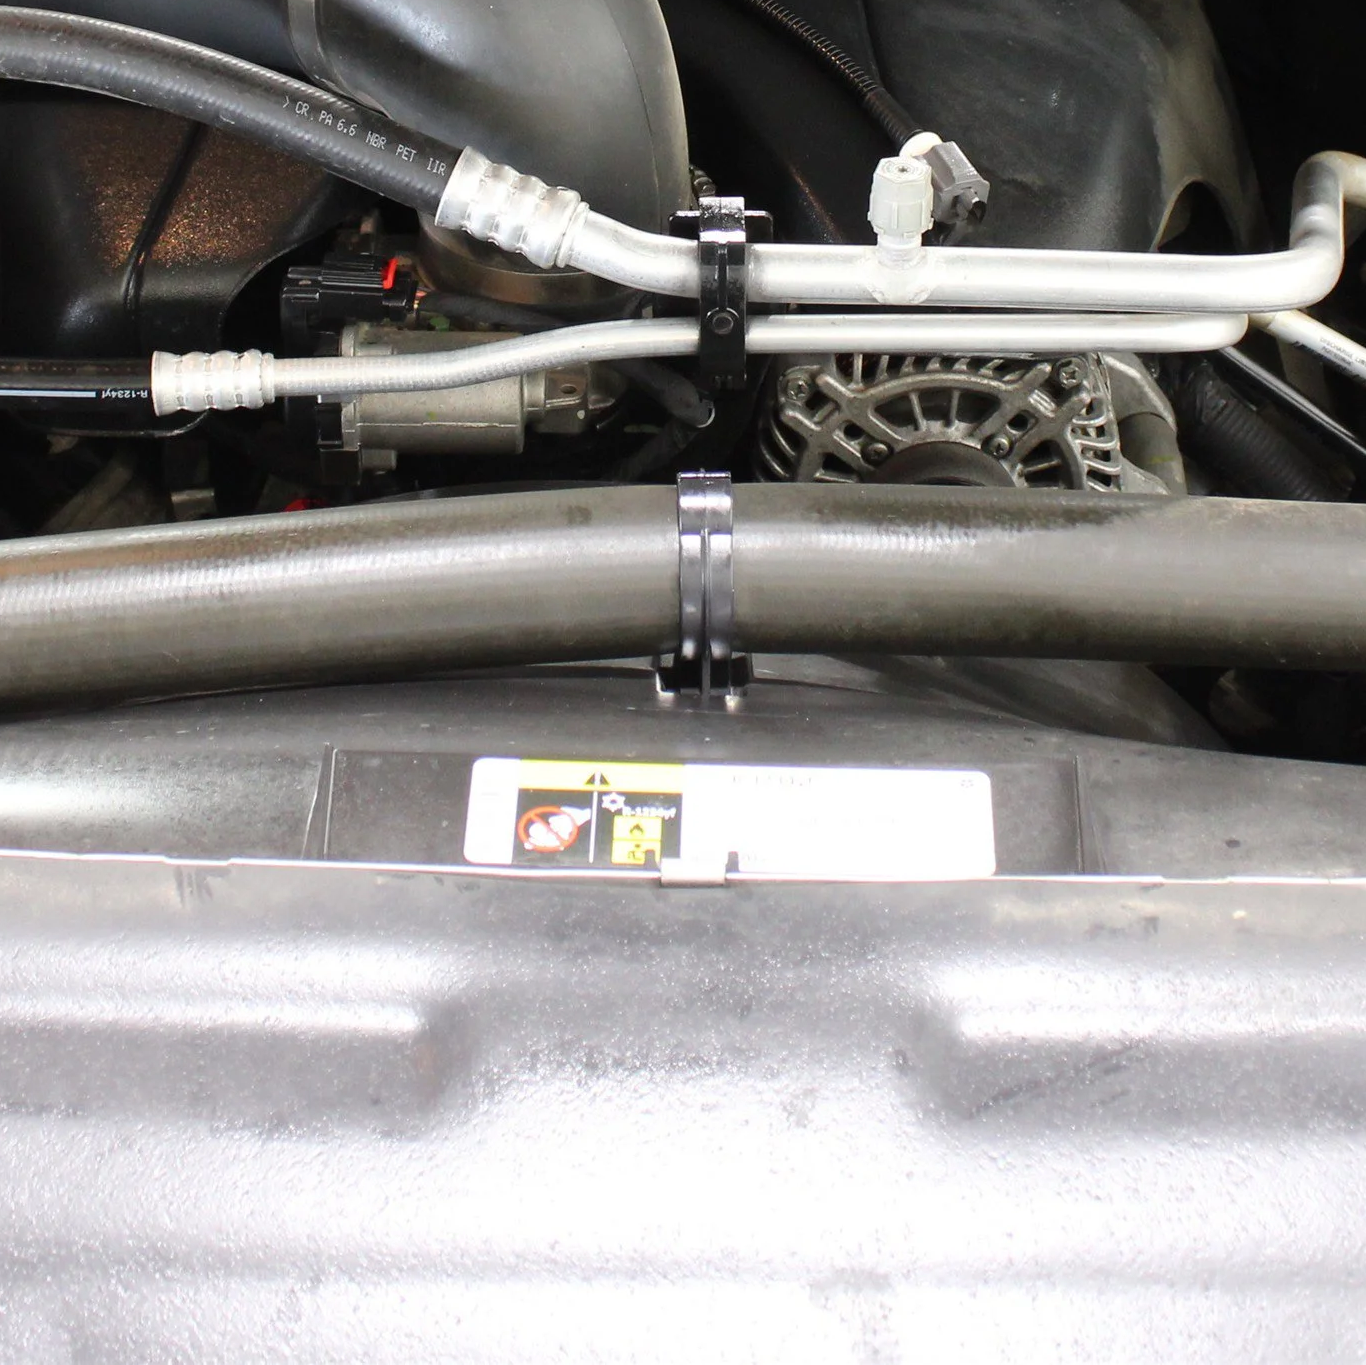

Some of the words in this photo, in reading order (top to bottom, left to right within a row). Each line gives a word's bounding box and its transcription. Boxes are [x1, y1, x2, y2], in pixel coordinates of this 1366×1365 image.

[318, 110, 334, 127] PA
[336, 118, 358, 137] 6.6
[364, 130, 388, 151] NBR
[395, 143, 418, 163] PET
[101, 387, 149, 400] R-1234yf
